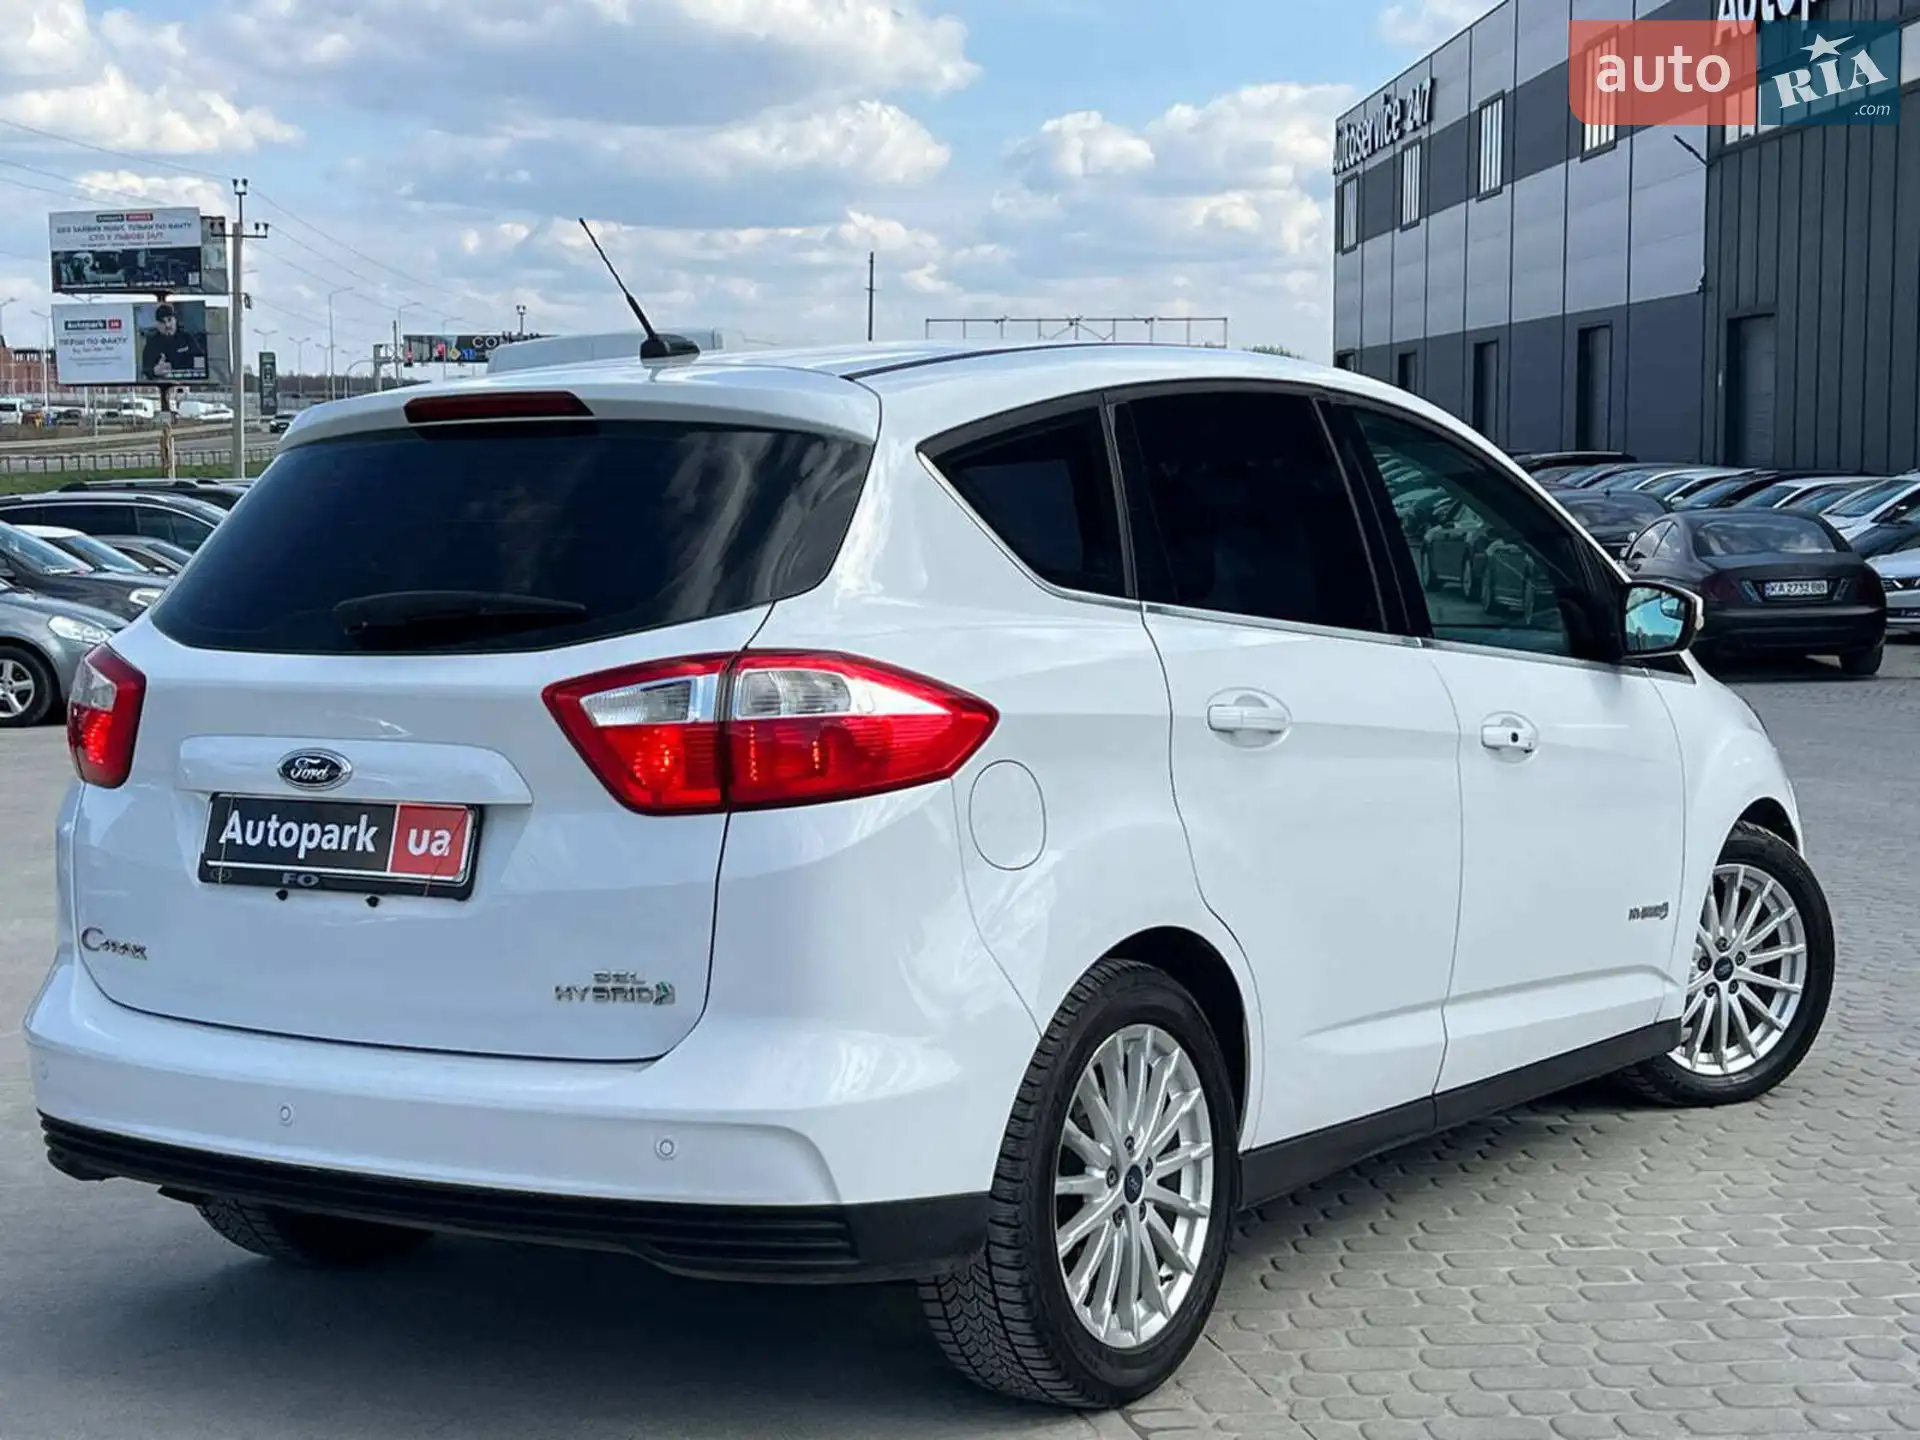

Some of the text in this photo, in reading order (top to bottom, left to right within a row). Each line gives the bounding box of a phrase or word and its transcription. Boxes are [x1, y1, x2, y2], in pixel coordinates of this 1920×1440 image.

[290, 757, 332, 780] Ford
[218, 810, 452, 859] Autopark ua
